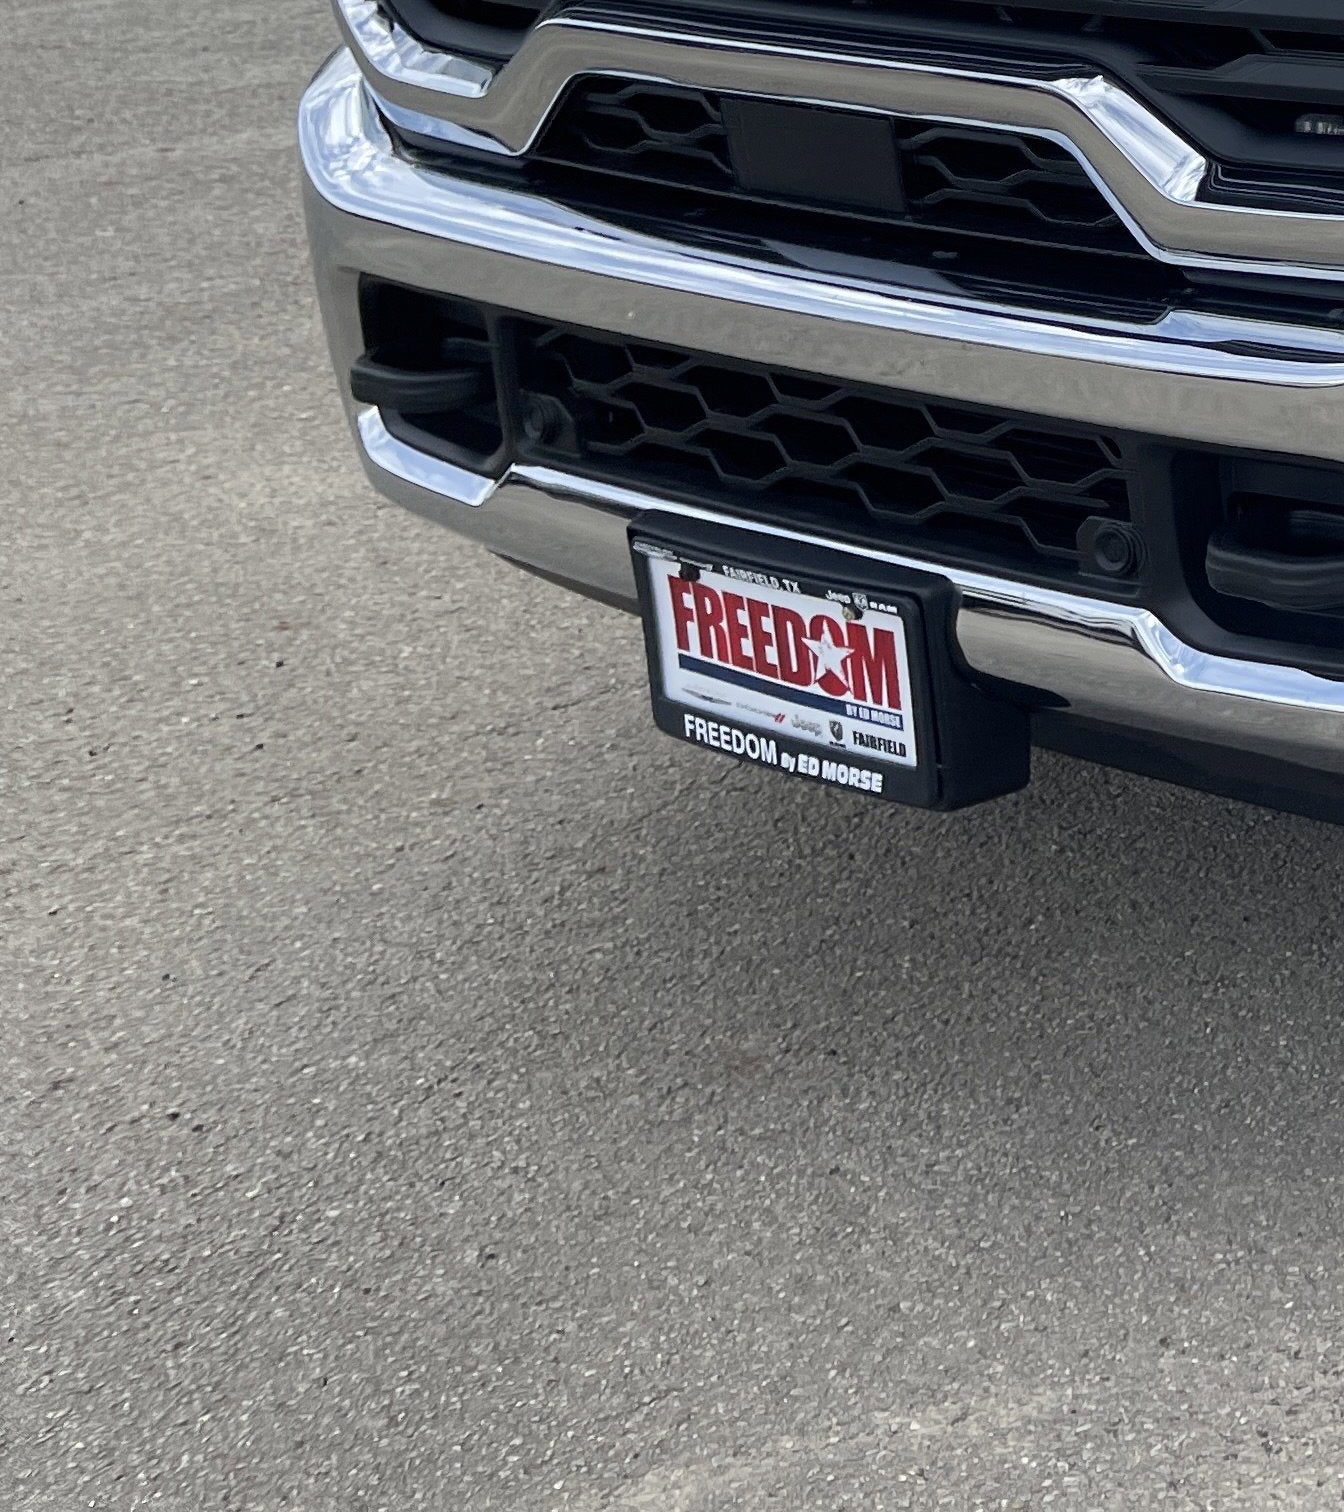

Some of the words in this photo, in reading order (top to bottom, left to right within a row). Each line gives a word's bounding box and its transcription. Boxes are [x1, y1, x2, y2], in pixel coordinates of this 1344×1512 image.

[667, 574, 902, 710] FREEDOM
[684, 713, 778, 765] FREEDOM
[797, 753, 820, 777] ED
[822, 759, 883, 793] MORSE
[853, 730, 906, 757] FAIRFIELD
